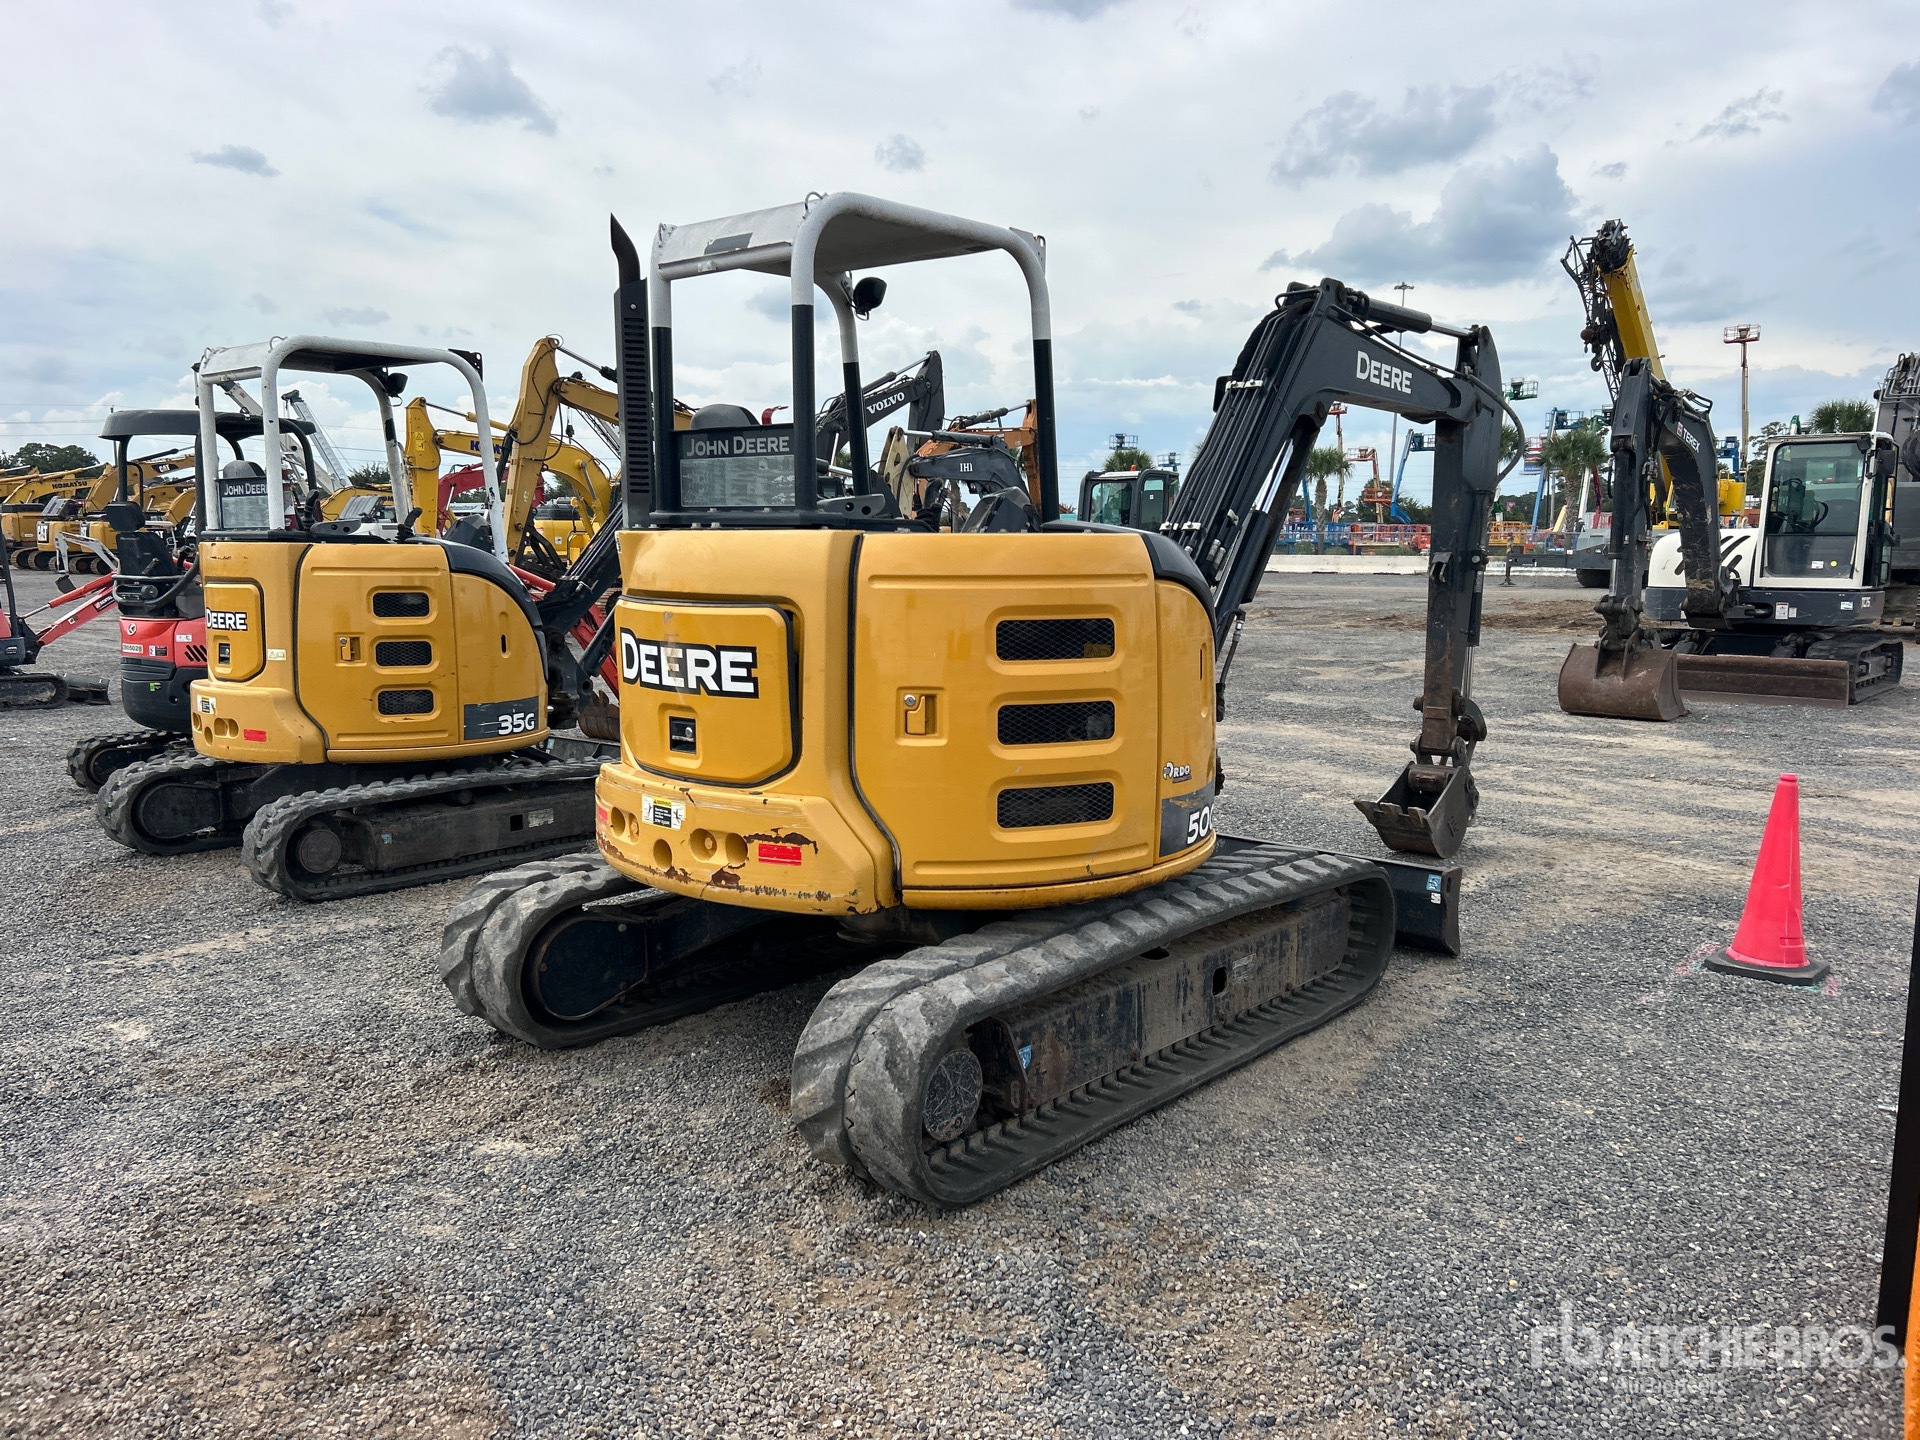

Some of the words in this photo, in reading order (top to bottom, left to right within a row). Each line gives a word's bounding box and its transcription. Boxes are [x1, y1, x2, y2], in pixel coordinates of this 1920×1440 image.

[1357, 350, 1413, 394] DEERE
[866, 391, 906, 415] VOLVO
[686, 438, 729, 457] JOHN
[733, 436, 790, 454] DEERE
[1683, 427, 1701, 453] TEREX
[158, 463, 171, 473] CAT
[51, 480, 88, 490] KOMATSU
[224, 483, 244, 496] JOHN
[245, 482, 268, 495] DEER
[206, 608, 247, 630] DEERE
[620, 631, 757, 695] DEERE
[498, 712, 535, 735] 35G
